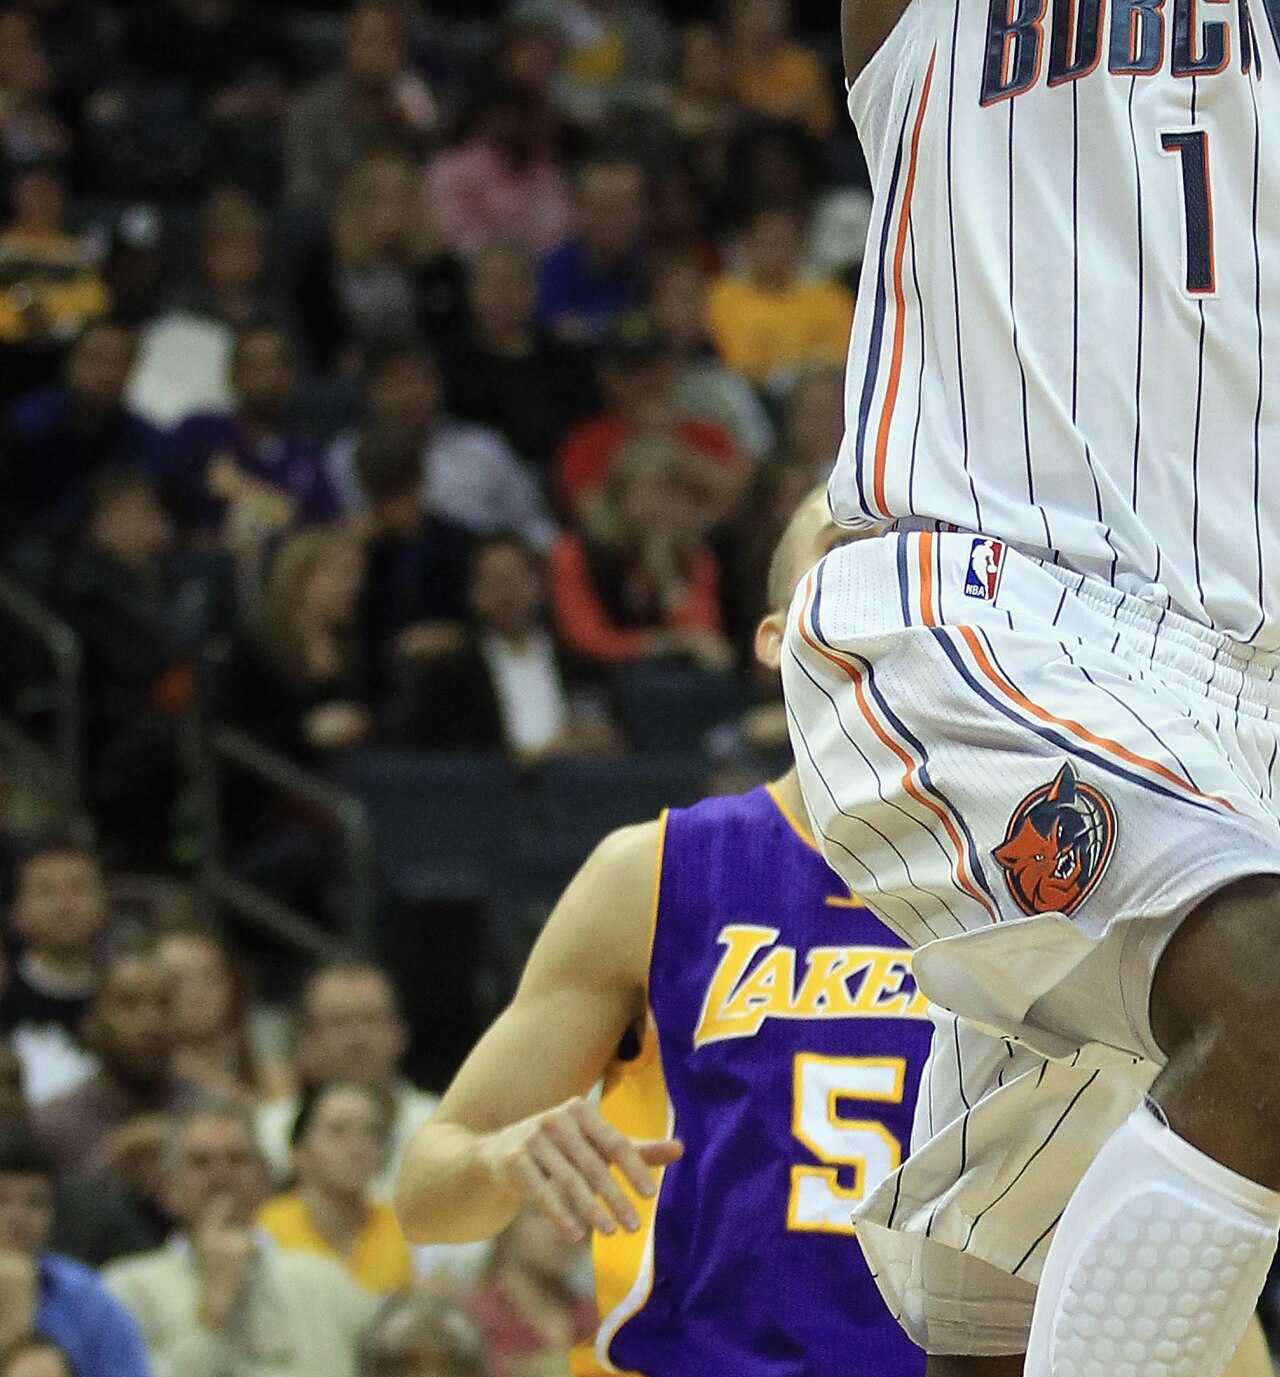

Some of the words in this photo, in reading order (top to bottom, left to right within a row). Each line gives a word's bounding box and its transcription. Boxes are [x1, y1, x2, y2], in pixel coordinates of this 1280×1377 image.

[1160, 130, 1216, 293] 1
[964, 583, 985, 598] NBA
[693, 924, 932, 1052] LAKE
[786, 1051, 907, 1235] 5
